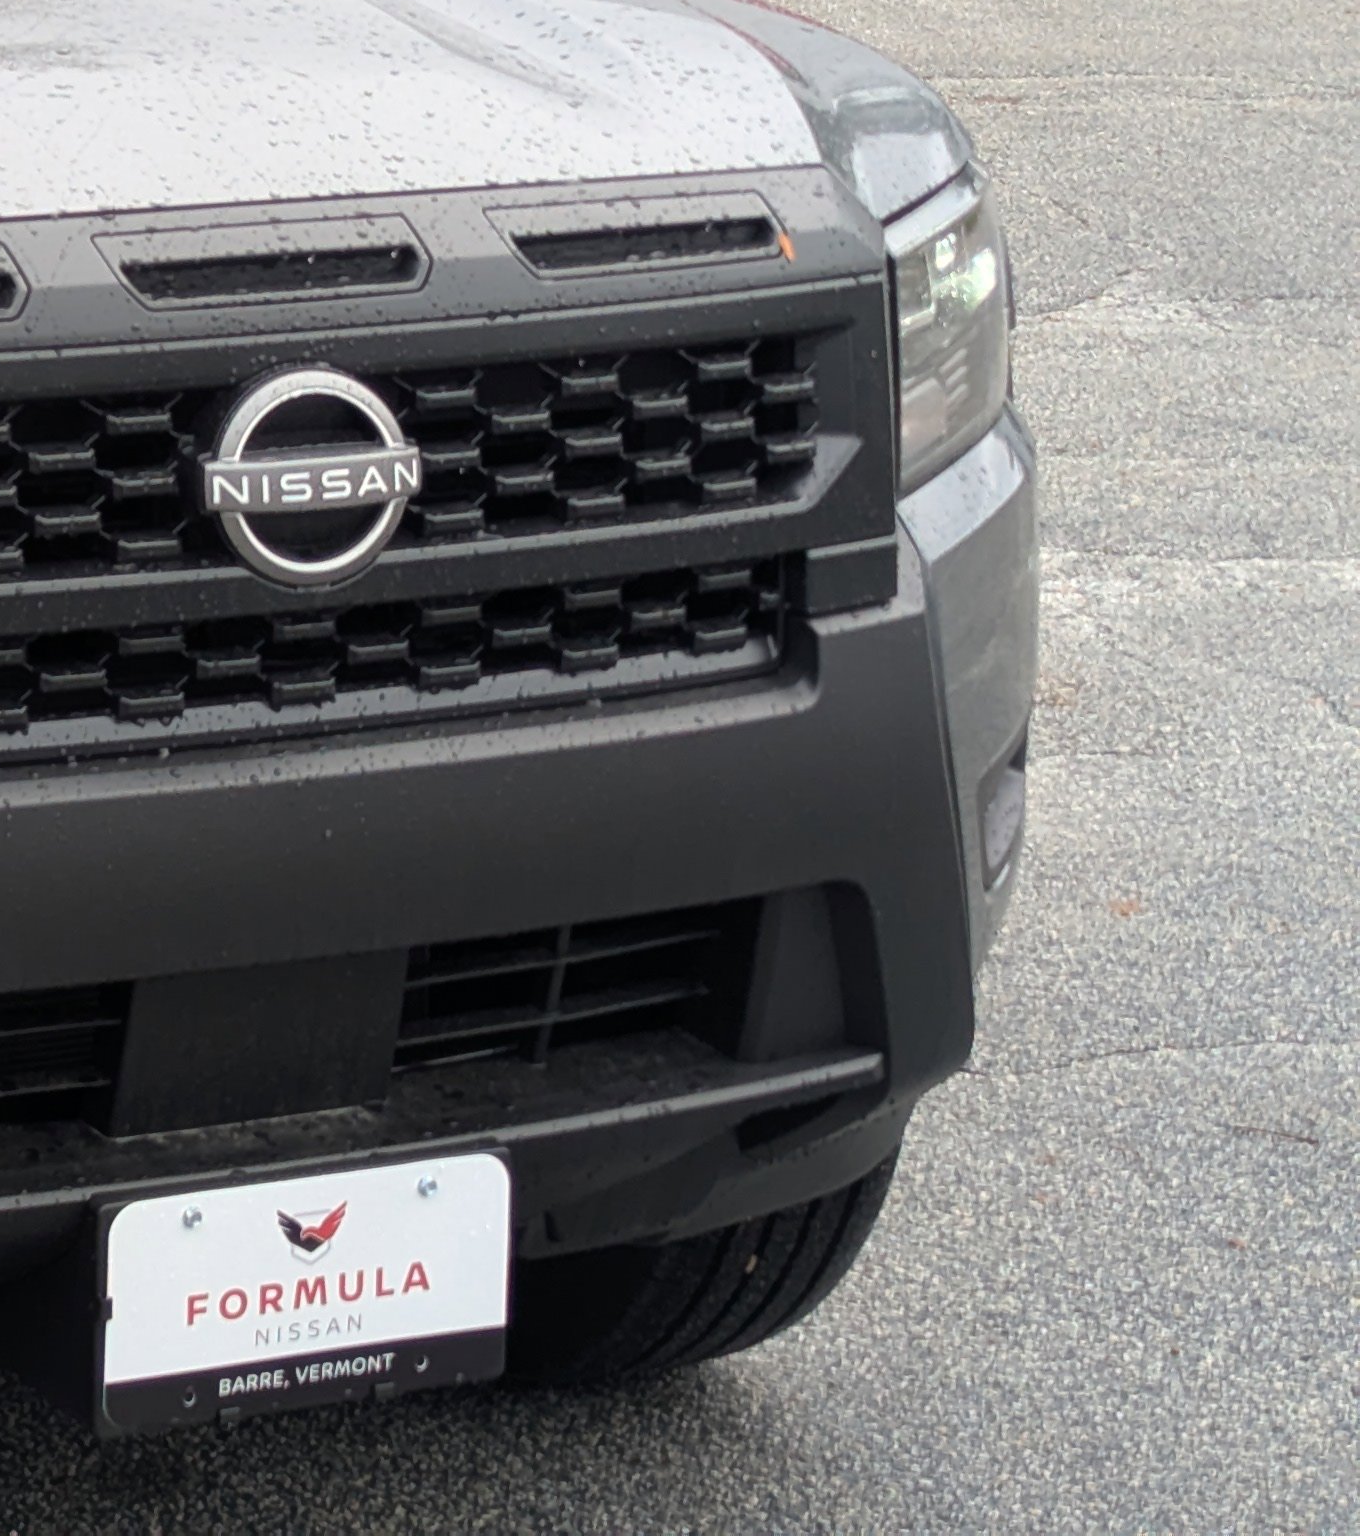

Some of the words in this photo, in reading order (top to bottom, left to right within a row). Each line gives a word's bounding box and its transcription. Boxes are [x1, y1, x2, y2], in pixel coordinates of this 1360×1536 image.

[212, 459, 418, 505] NISSAN
[186, 1261, 431, 1326] FORMULA
[254, 1313, 363, 1347] NISSAN
[218, 1370, 291, 1399] BARRE,
[295, 1352, 396, 1384] VERMONT
